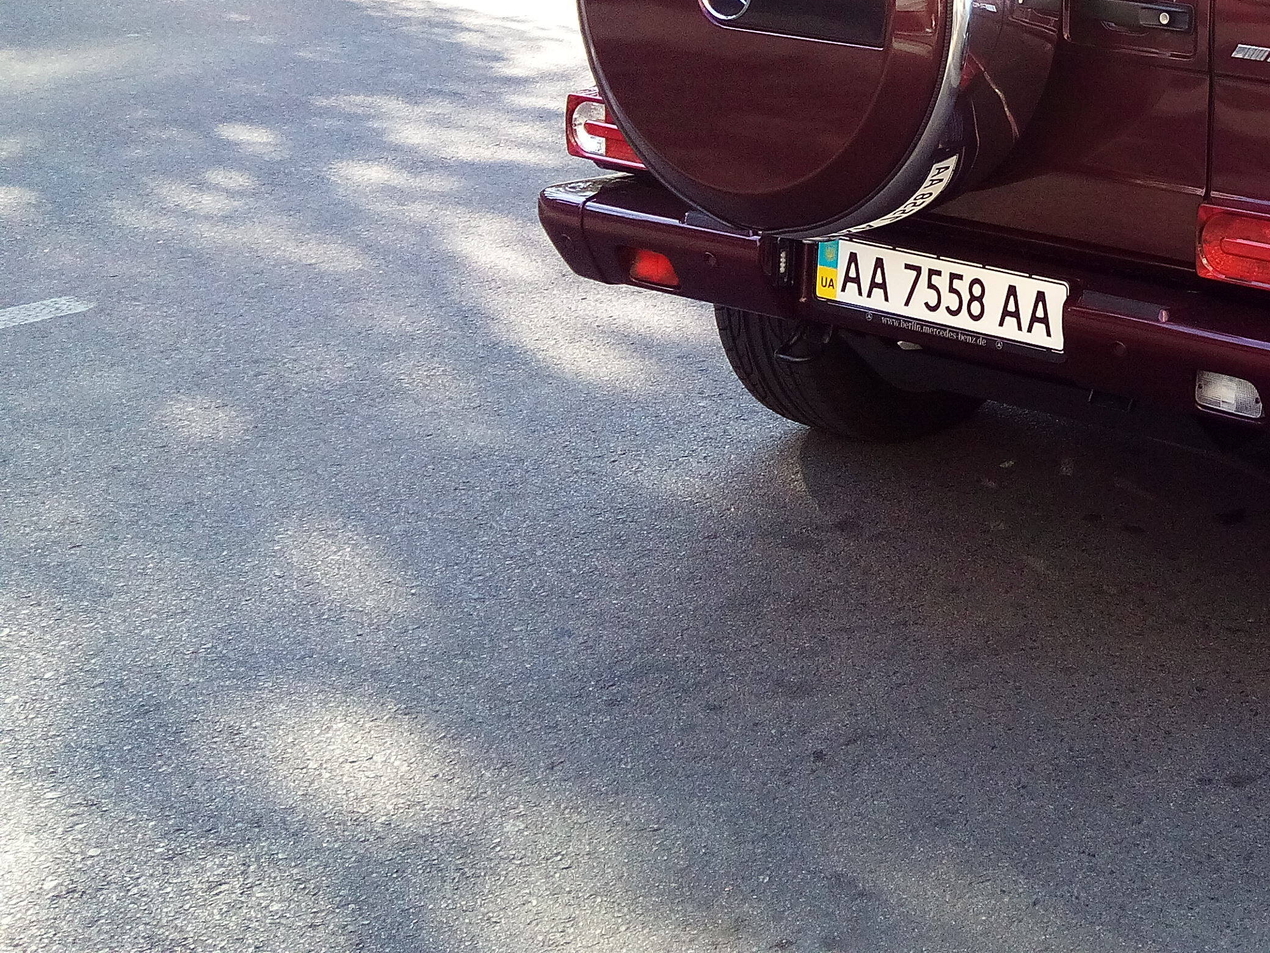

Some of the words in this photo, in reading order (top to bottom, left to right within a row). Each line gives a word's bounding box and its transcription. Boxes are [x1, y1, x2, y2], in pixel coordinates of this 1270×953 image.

[820, 275, 835, 290] UA
[841, 251, 890, 302] AA
[904, 262, 986, 322] 7558
[998, 284, 1052, 338] AA
